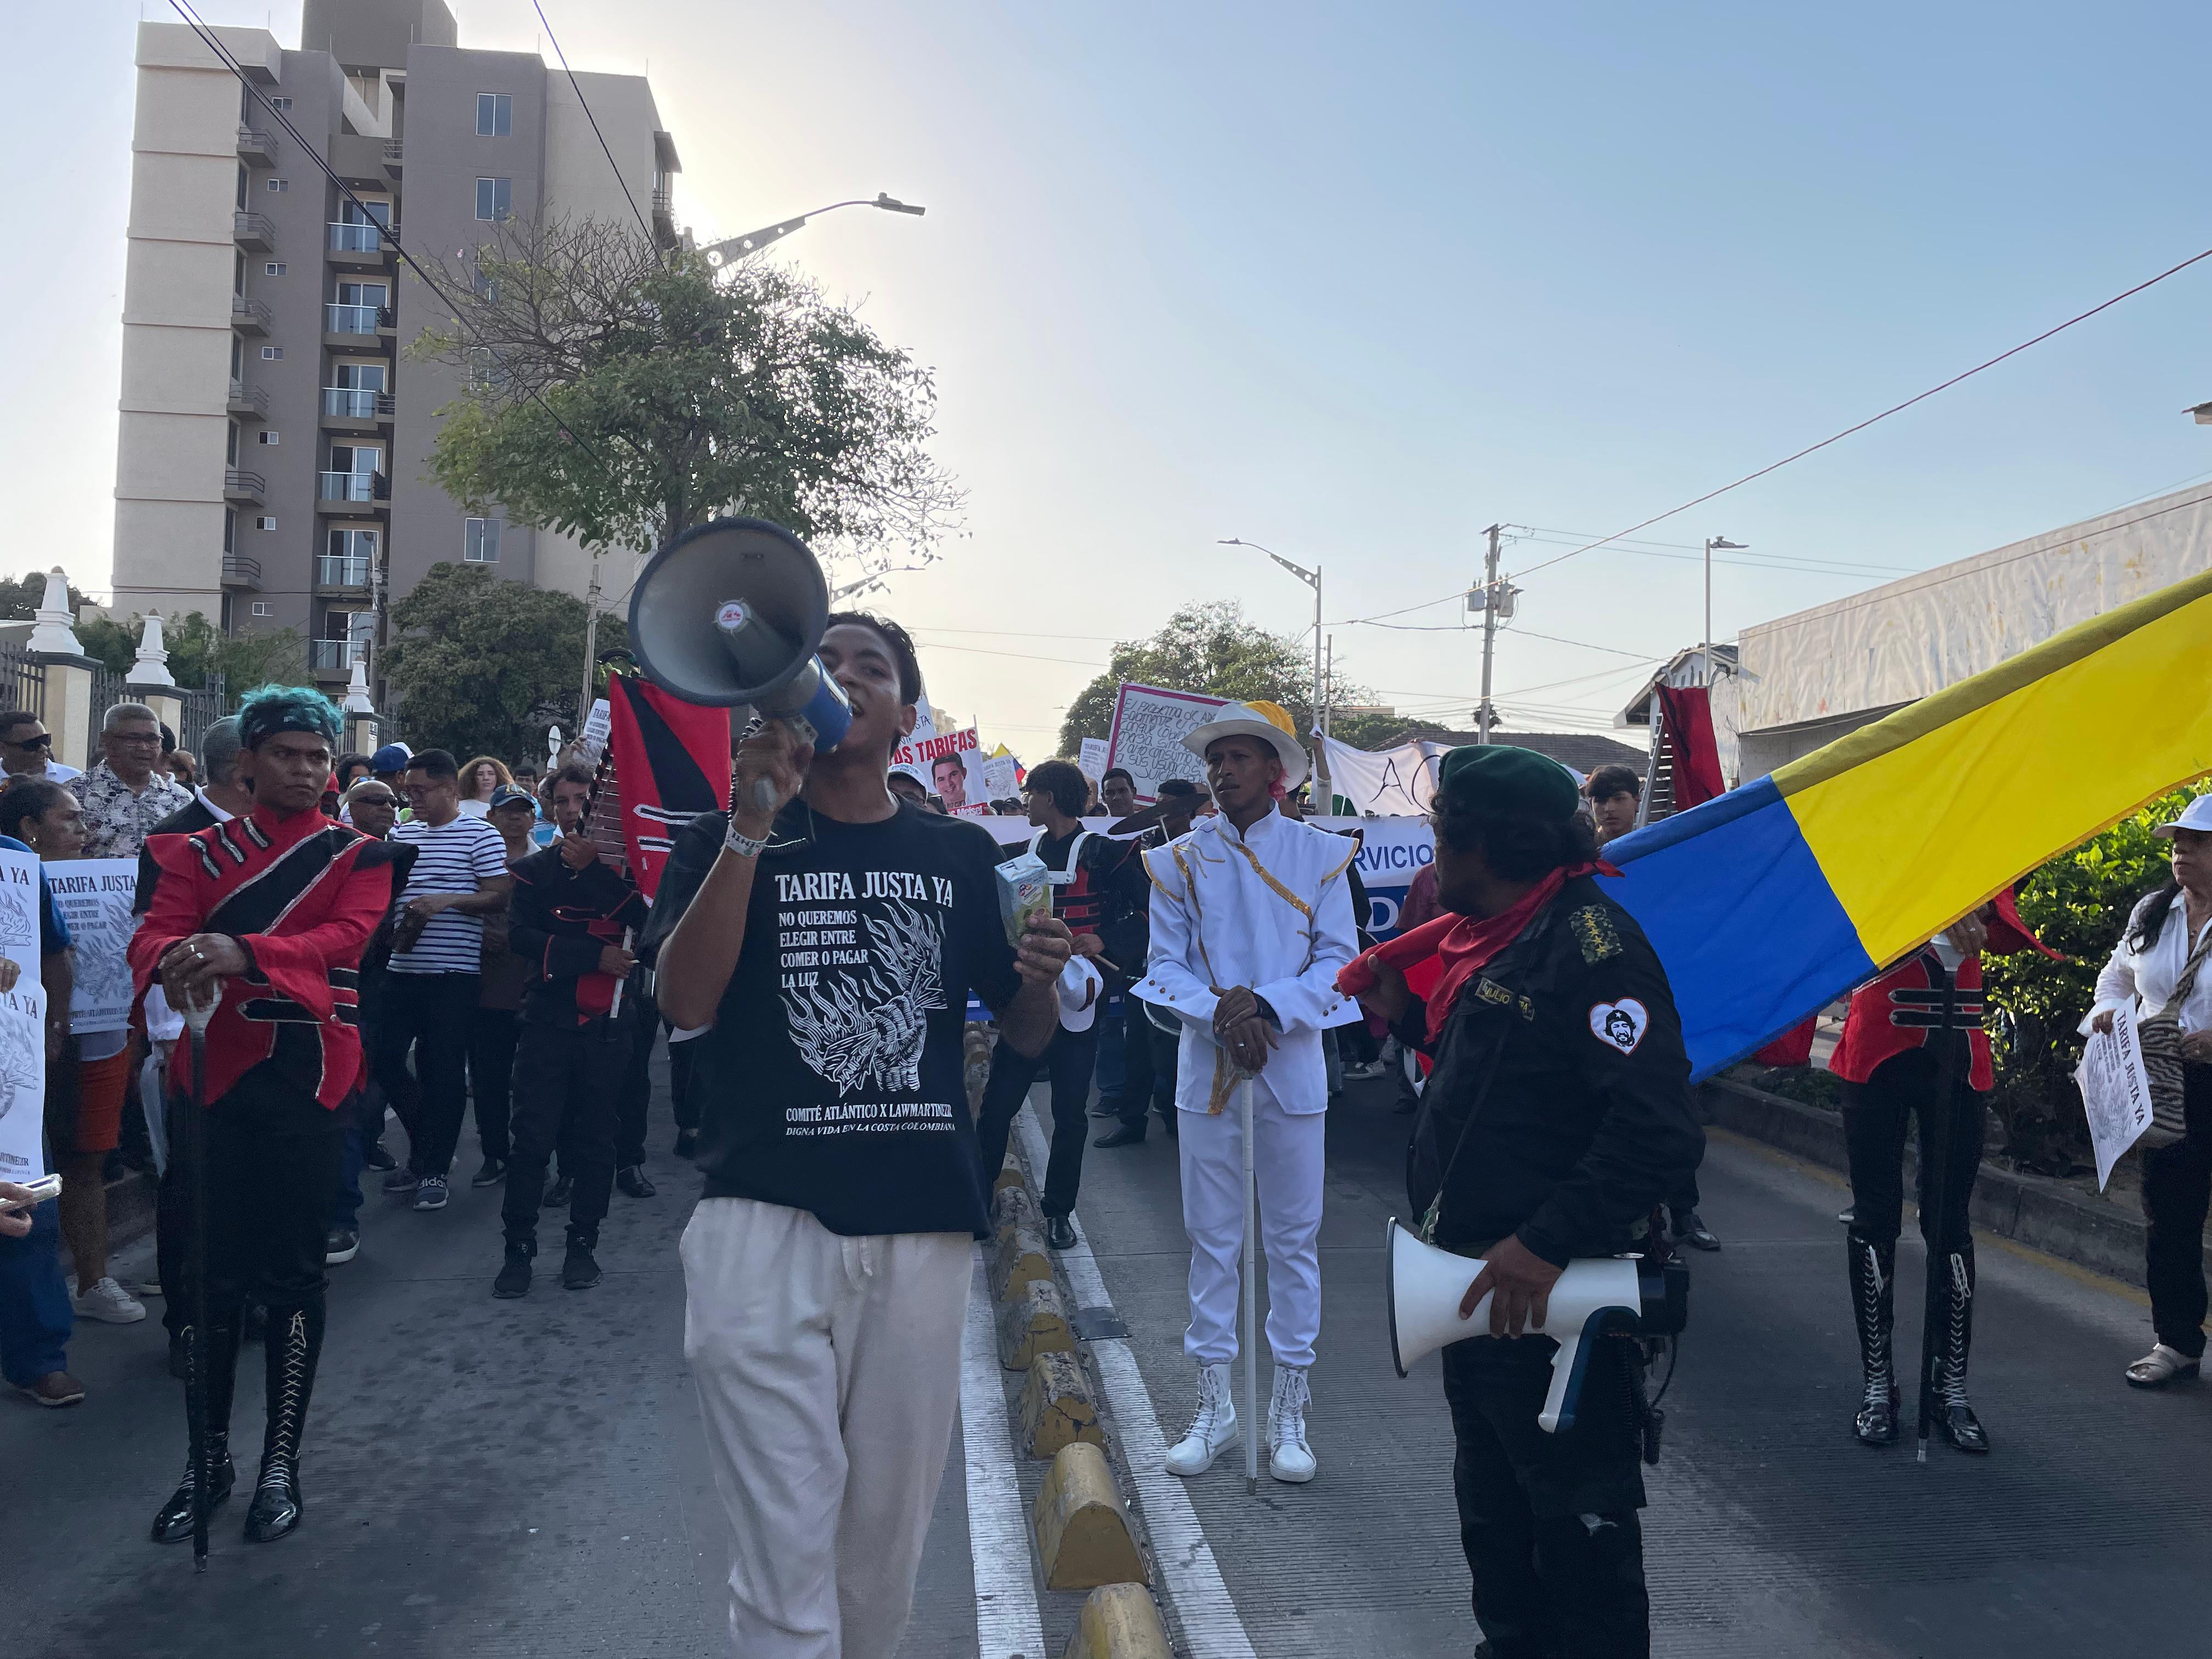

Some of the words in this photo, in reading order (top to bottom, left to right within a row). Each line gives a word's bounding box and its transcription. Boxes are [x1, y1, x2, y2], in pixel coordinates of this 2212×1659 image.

[915, 729, 977, 762] TARIFAS
[10, 866, 30, 885] YA
[49, 876, 98, 894] TARIFA
[775, 871, 856, 902] TARIFA
[861, 871, 928, 901] JUSTA
[932, 876, 953, 908] YA
[778, 912, 795, 927] NO
[798, 910, 857, 928] QUEREMOS
[780, 931, 819, 947] ELEGIR
[821, 929, 856, 945] ENTRE
[781, 952, 819, 968] COMER
[822, 952, 830, 966] O
[832, 949, 869, 965] PAGAR
[782, 973, 796, 988] LA
[798, 972, 819, 987] LUZ
[22, 995, 38, 1019] YA
[2117, 1010, 2131, 1060] TARIFA
[2124, 1061, 2140, 1105] JUSTA
[2134, 1103, 2146, 1125] YA
[786, 1105, 822, 1122] COMITÉ
[824, 1103, 877, 1120] ATLÁNTICO
[879, 1104, 887, 1117] X
[786, 1127, 815, 1136] DIGNA
[817, 1126, 840, 1135] VIDA
[842, 1124, 856, 1133] EN
[871, 1123, 900, 1131] COSTA
[901, 1122, 955, 1131] COLOMBIANA
